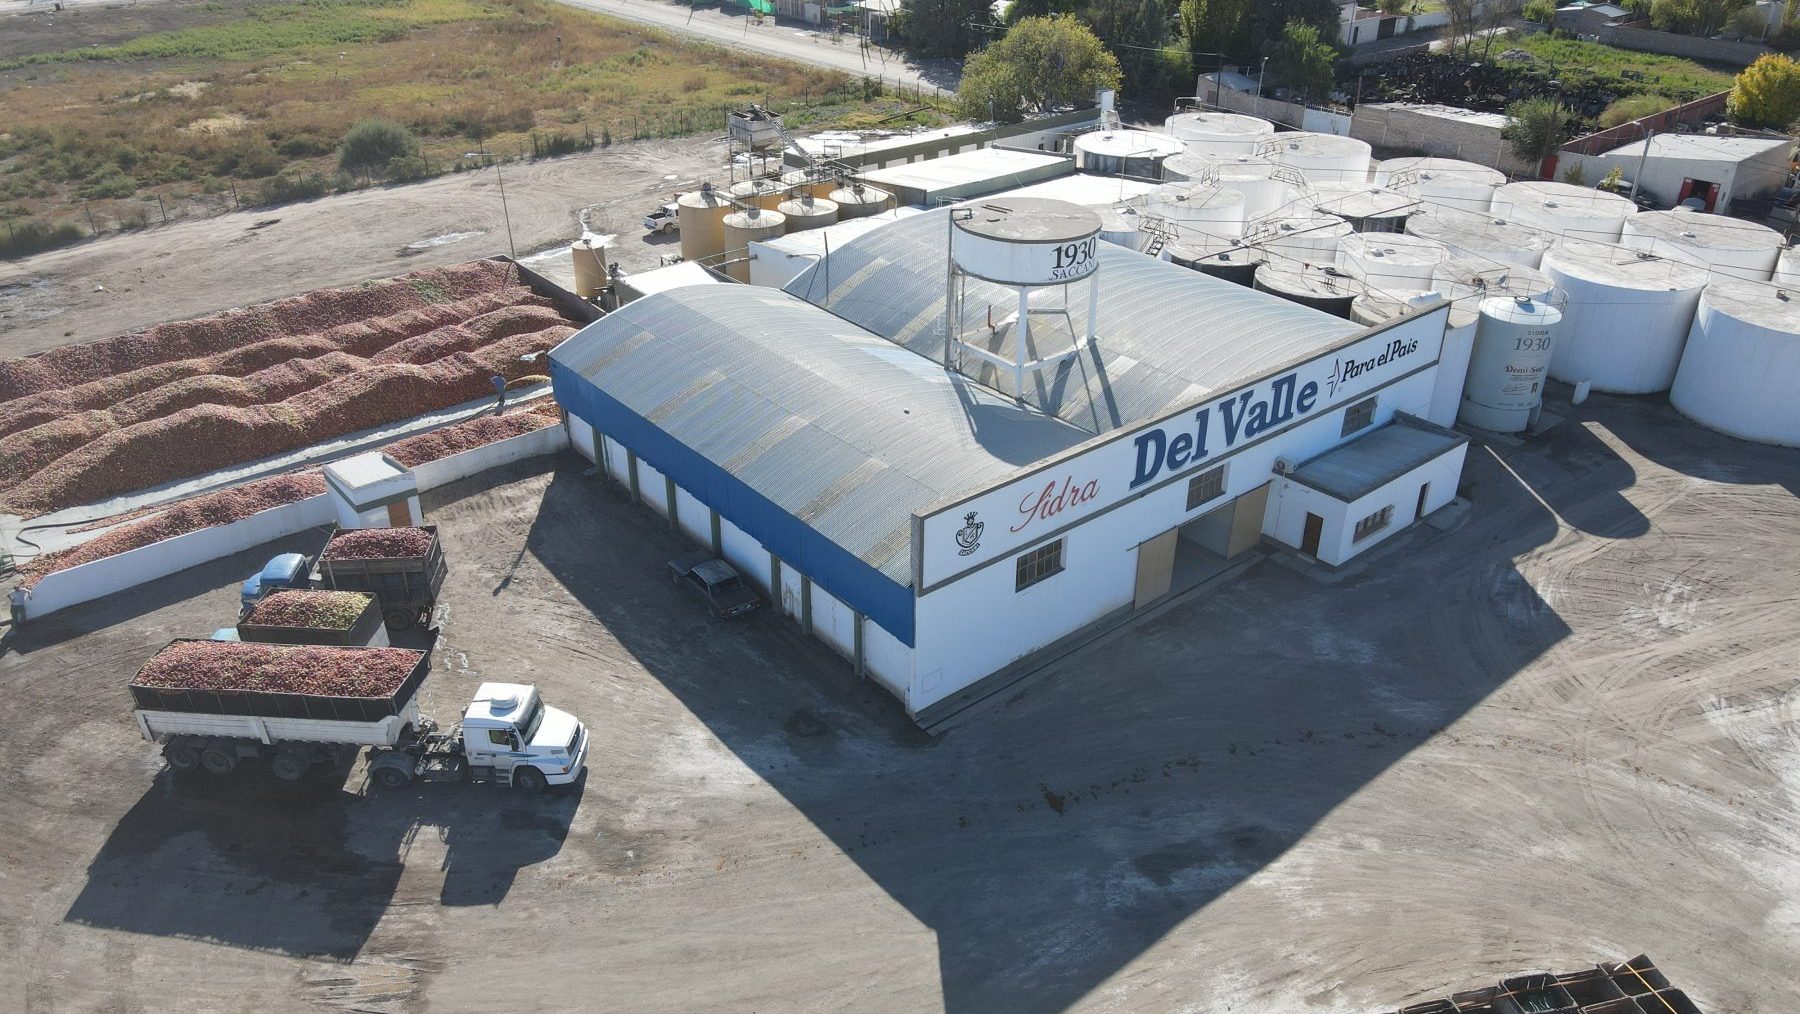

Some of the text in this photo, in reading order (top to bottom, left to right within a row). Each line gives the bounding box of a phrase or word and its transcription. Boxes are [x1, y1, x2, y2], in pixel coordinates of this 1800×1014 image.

[1049, 259, 1095, 281] SACCAN
[1052, 236, 1096, 269] 1930
[1513, 337, 1551, 351] 1930
[1341, 359, 1375, 383] Para
[1377, 343, 1391, 366] el
[1129, 372, 1318, 491] Del Valle
[1010, 475, 1100, 533] Sidra
